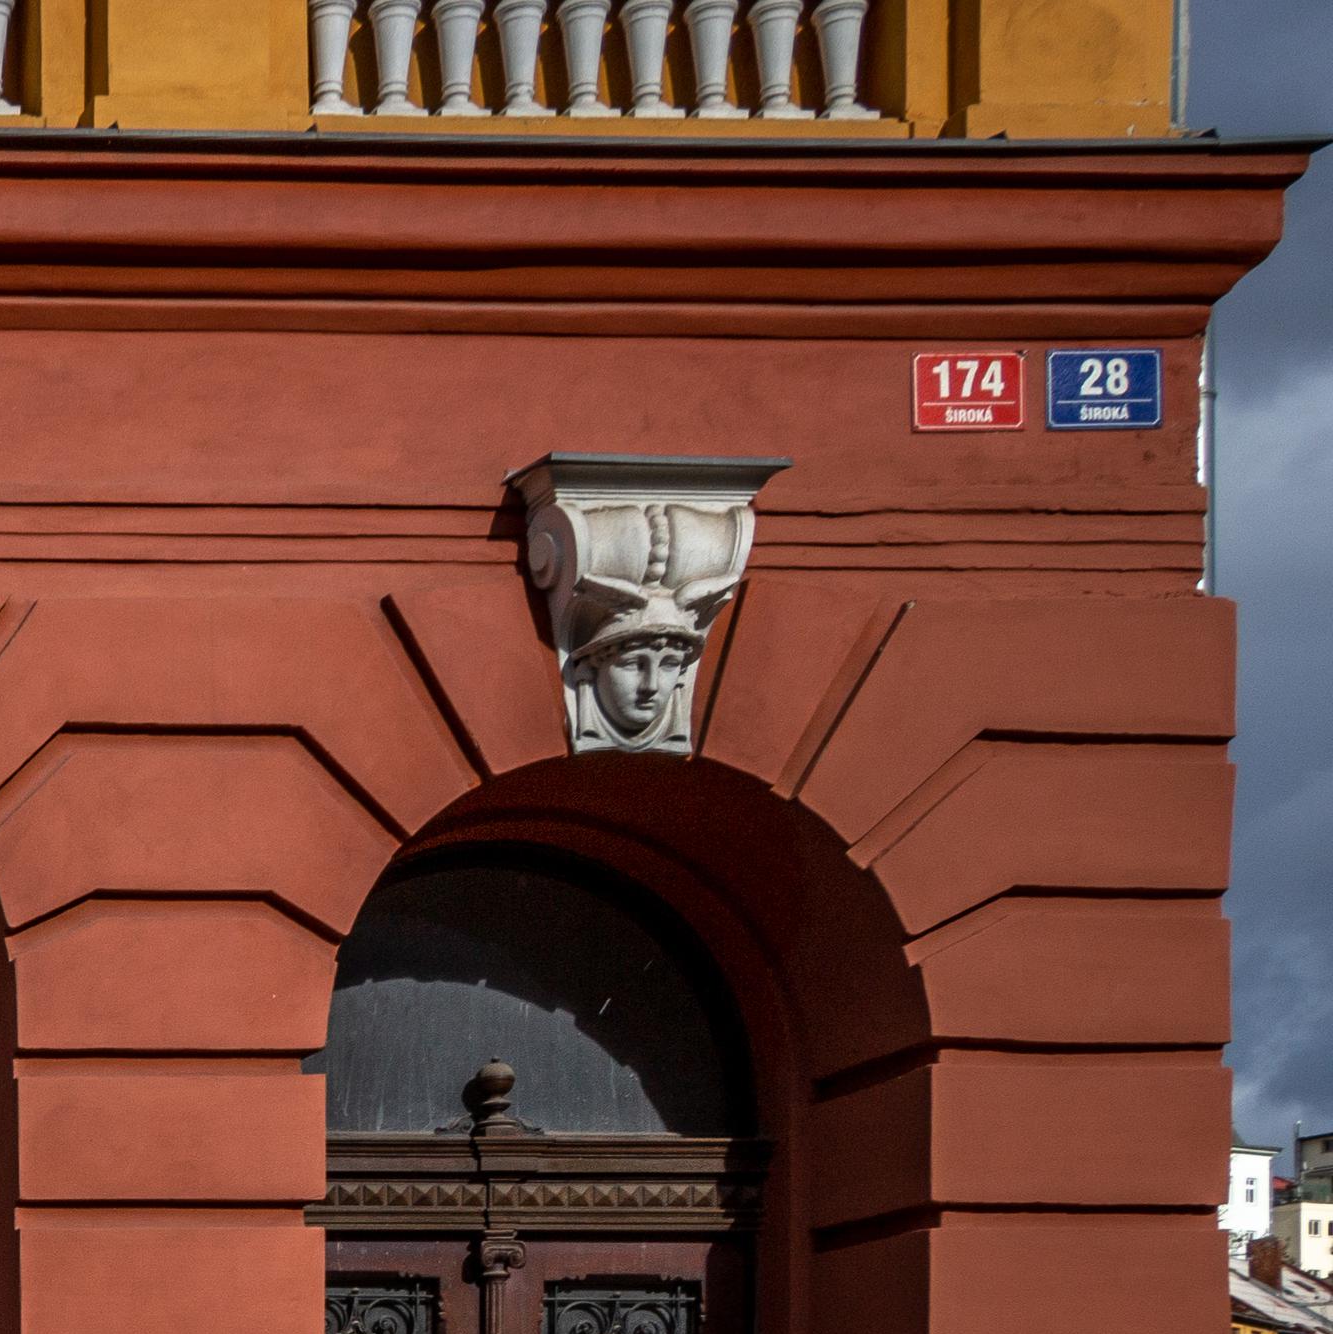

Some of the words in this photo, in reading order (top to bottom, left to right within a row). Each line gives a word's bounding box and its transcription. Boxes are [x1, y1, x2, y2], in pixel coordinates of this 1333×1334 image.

[932, 360, 1005, 398] 174
[1079, 358, 1130, 396] 28
[945, 405, 994, 423] ŠIROKÁ
[1079, 403, 1129, 422] ŠIROKÁ
